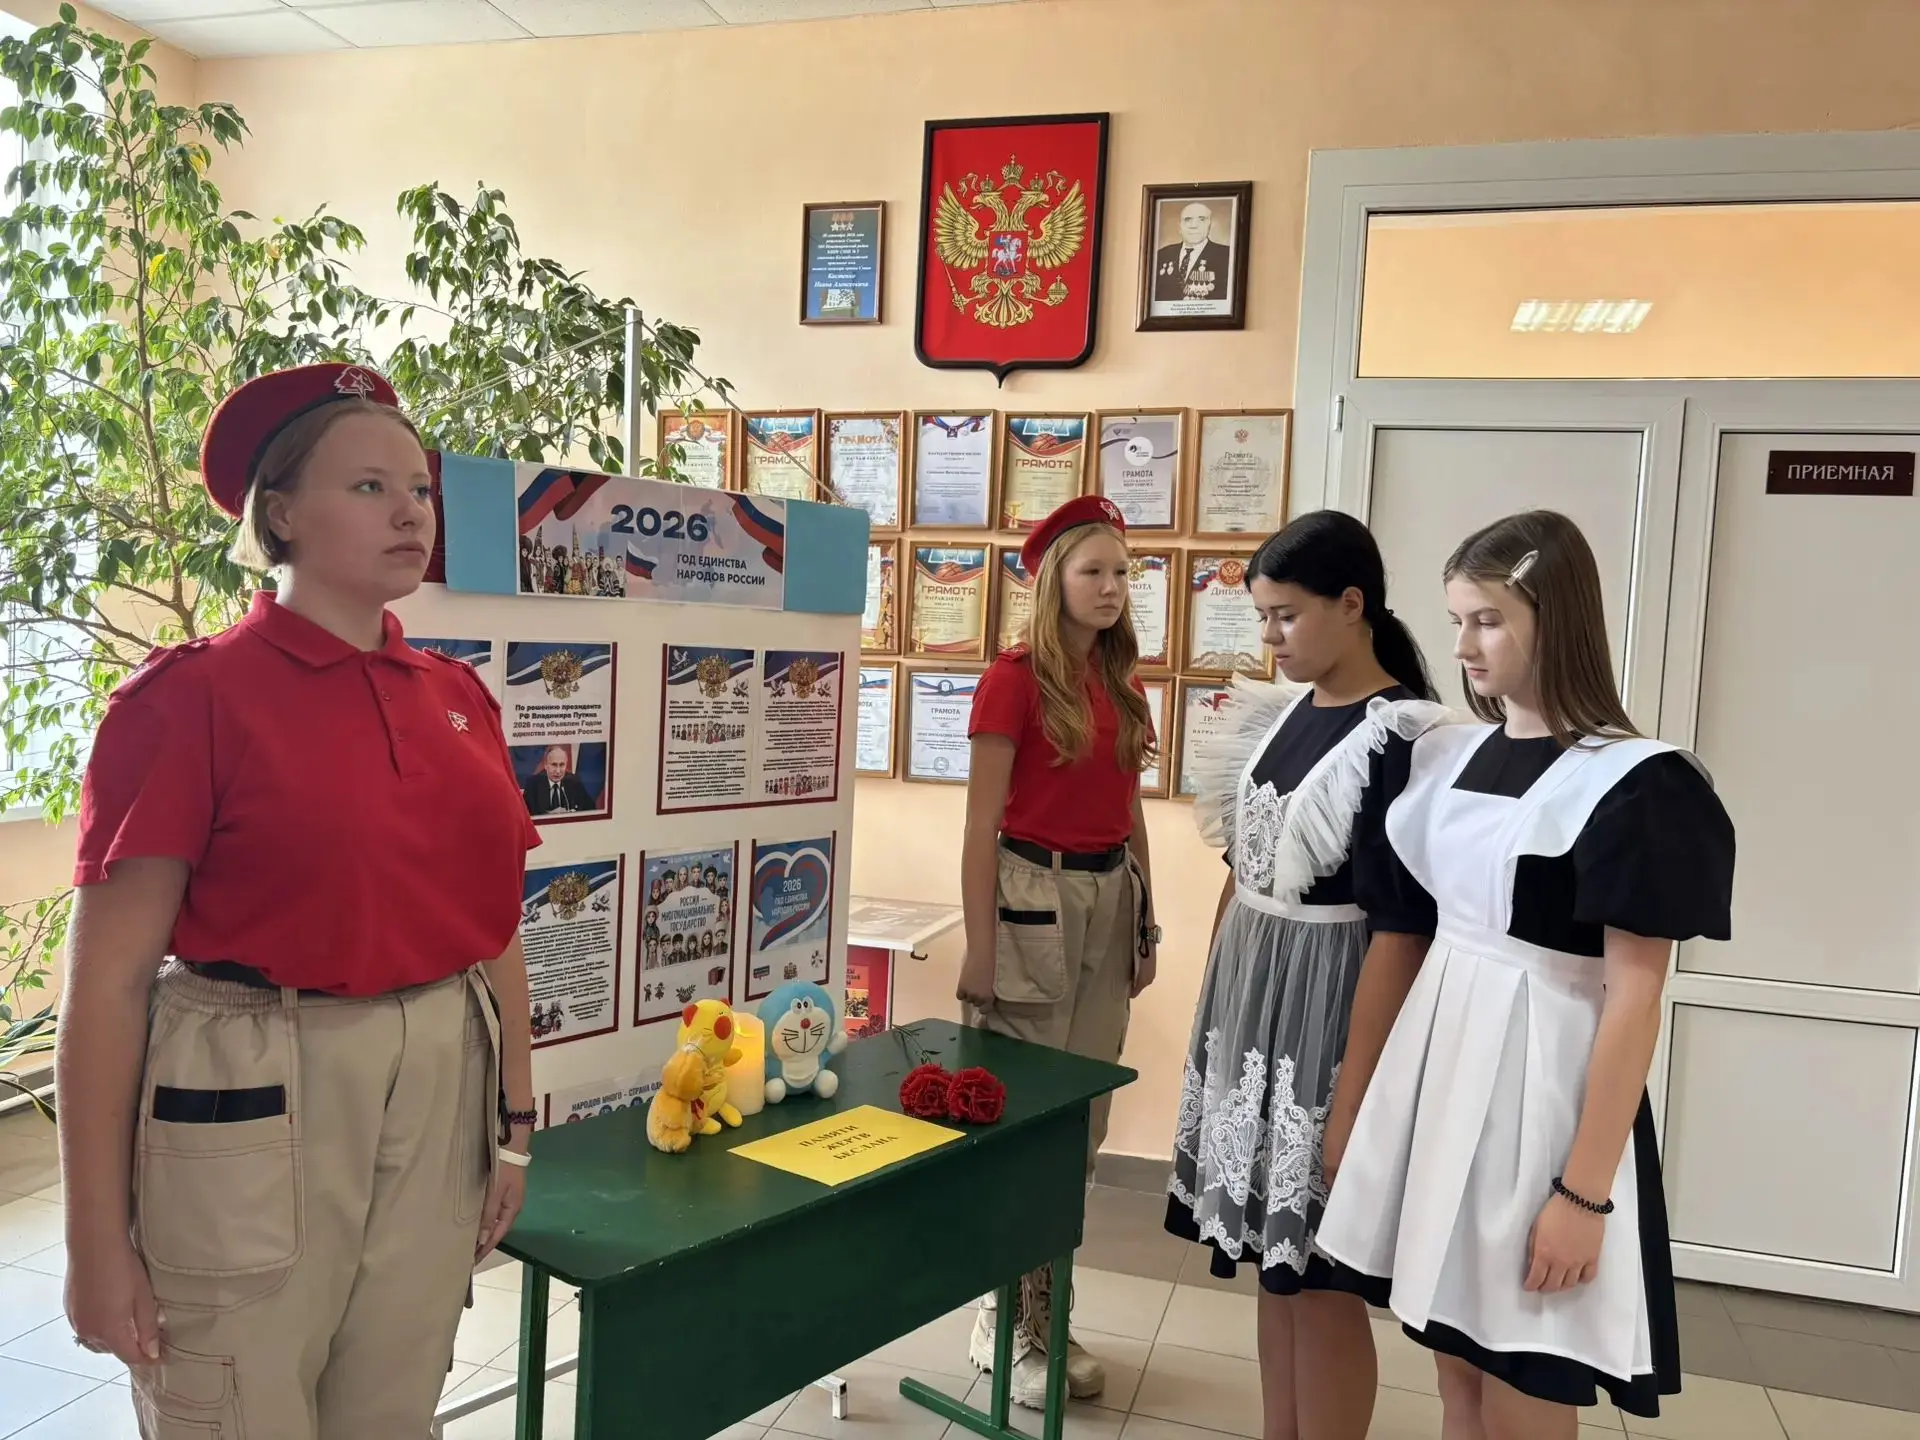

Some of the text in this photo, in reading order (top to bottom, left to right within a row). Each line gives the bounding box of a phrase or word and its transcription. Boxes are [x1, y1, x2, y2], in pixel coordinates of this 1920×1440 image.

[1015, 458, 1073, 468] ГРАМОТА
[1122, 470, 1153, 478] ГРАМОТА
[1787, 464, 1895, 480] ПРИЕМНАЯ
[610, 504, 709, 542] 2026
[677, 553, 747, 570] ГОД ЕДИНСТВА
[676, 569, 766, 586] НАРОДОВ РОССИИ
[922, 585, 977, 596] ГРАМОТА
[931, 707, 960, 715] ГРАМОТА
[783, 879, 801, 892] 2026
[680, 895, 700, 907] РОССИЯ
[670, 916, 707, 932] ГОСУДАРСТВО
[571, 1098, 602, 1112] НАРОДОВ
[602, 1091, 622, 1104] МНОГО
[629, 1084, 650, 1097] СТРАНА
[799, 1124, 859, 1148] ПАМЯТИ
[822, 1132, 871, 1151] ЖЕРТВ
[833, 1136, 898, 1160] БЕСЛАНА
